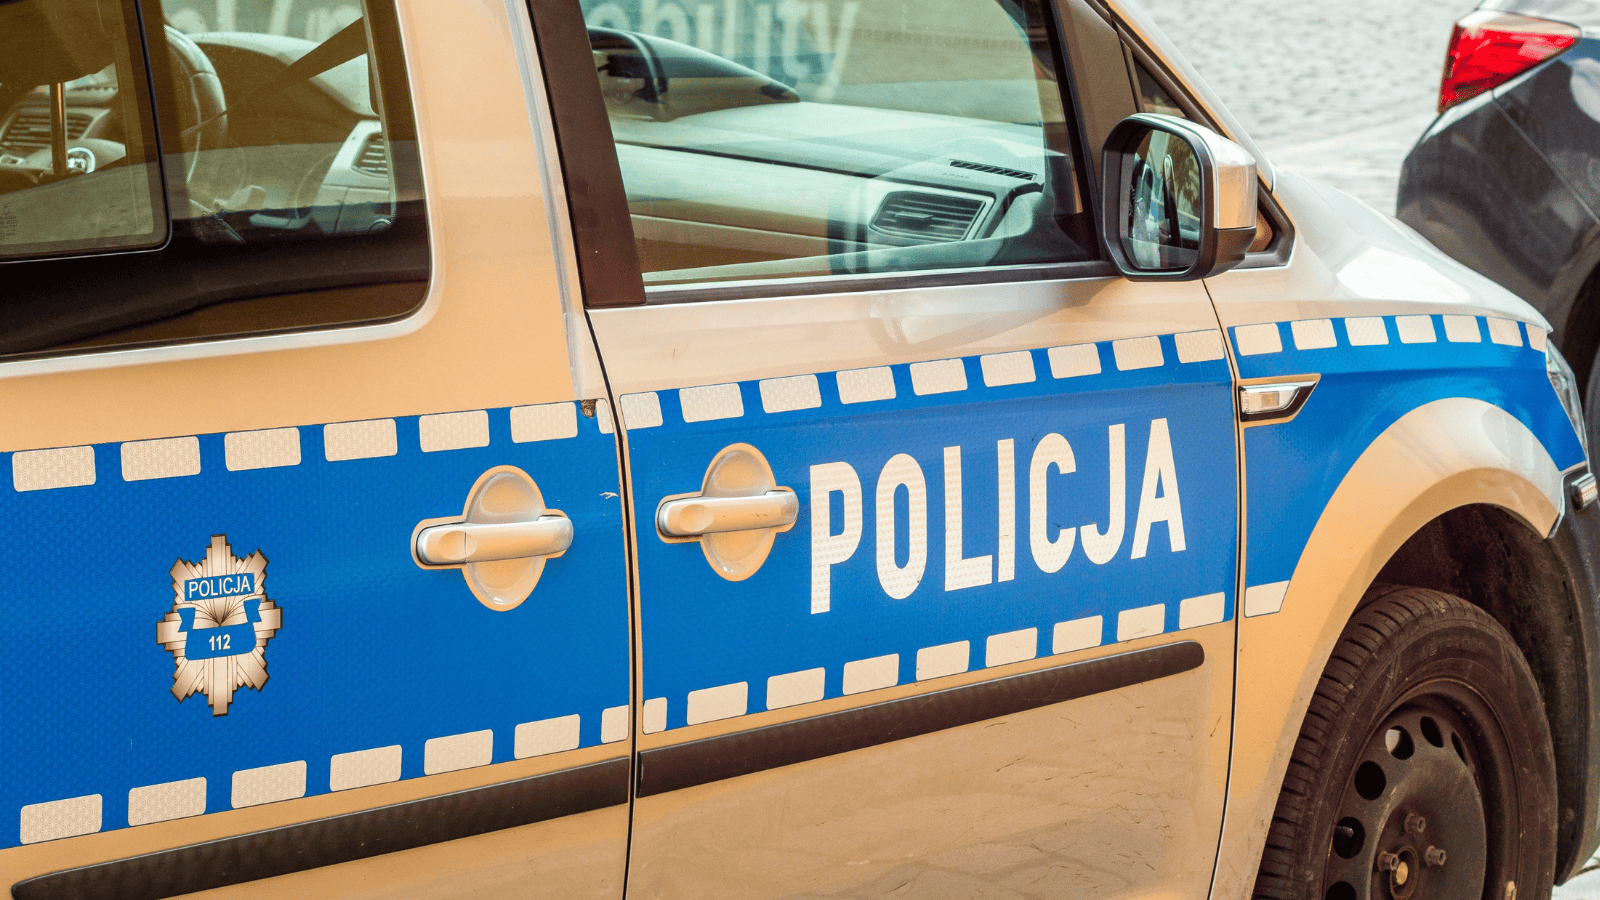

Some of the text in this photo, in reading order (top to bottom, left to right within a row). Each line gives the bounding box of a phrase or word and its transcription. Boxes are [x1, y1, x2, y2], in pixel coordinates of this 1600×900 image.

[809, 417, 1187, 615] POLICJA
[188, 575, 251, 599] POLICJA
[208, 633, 231, 652] 112
